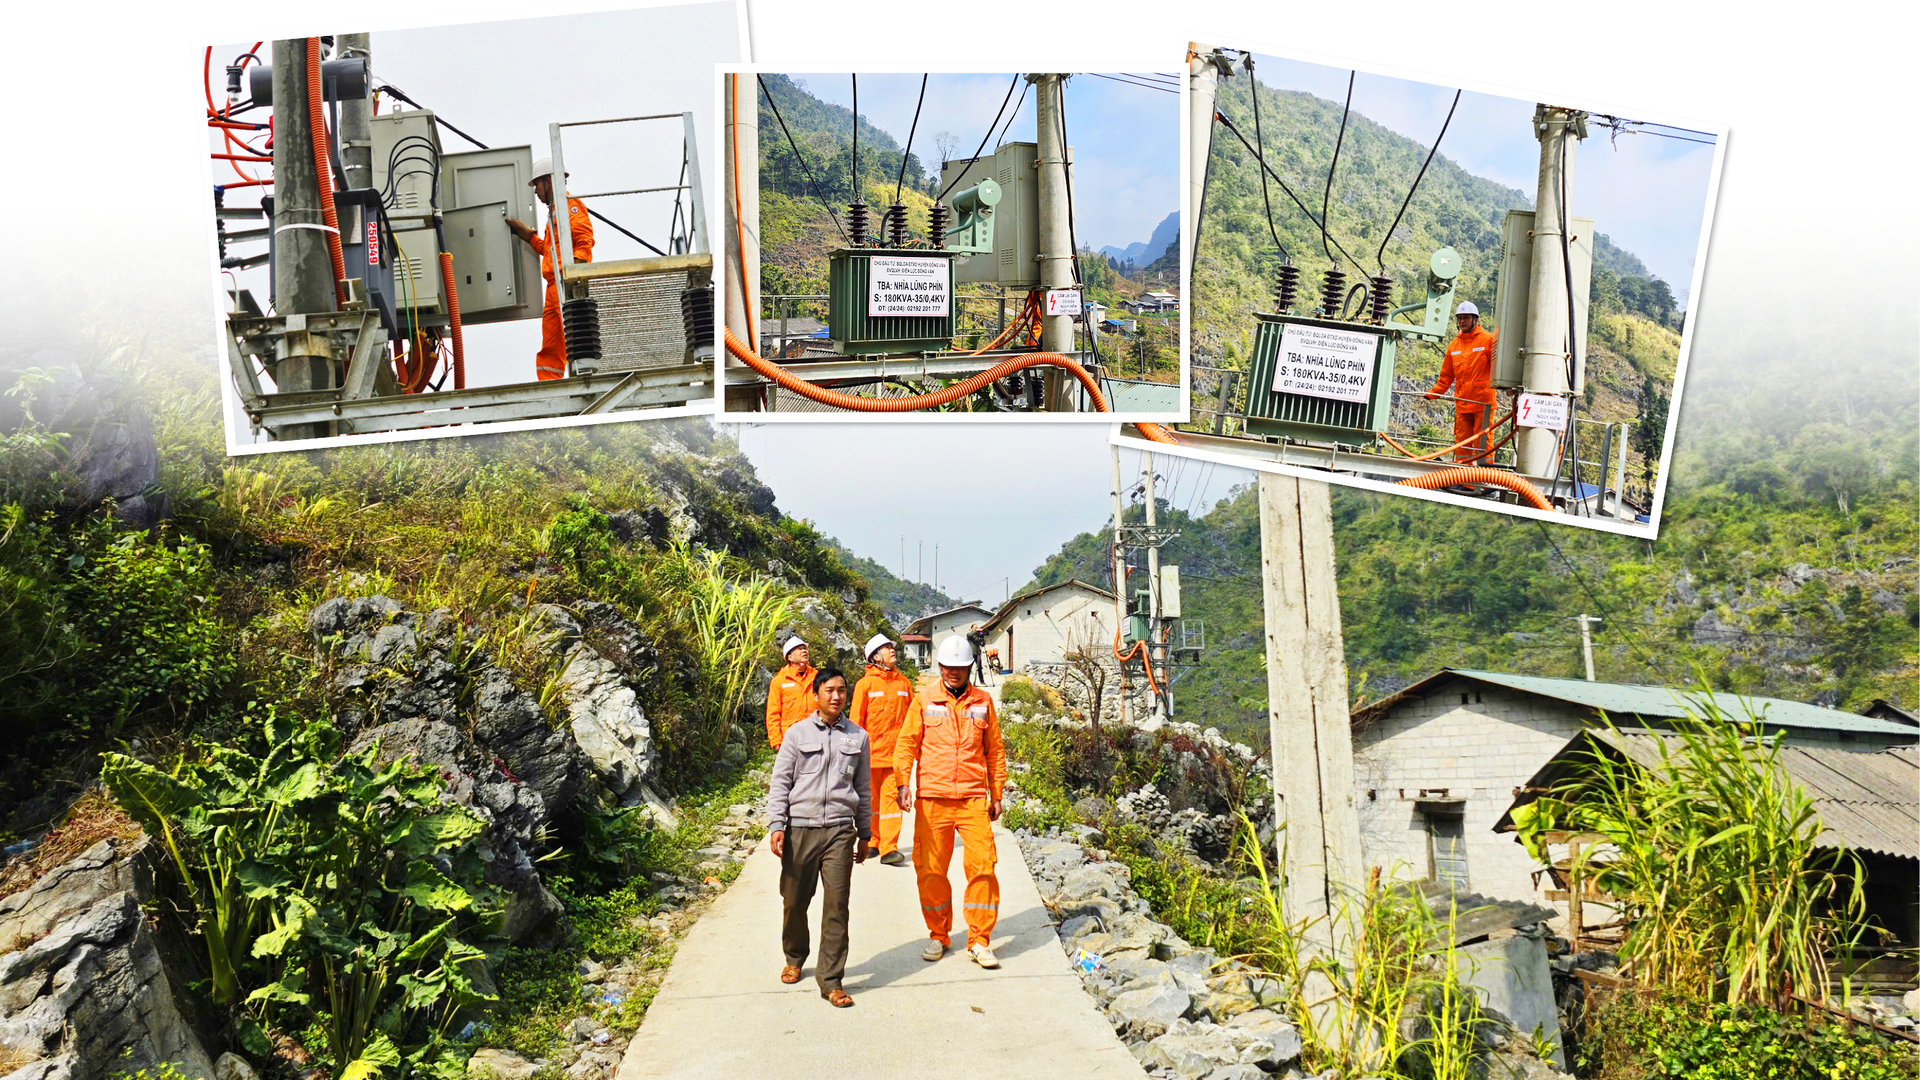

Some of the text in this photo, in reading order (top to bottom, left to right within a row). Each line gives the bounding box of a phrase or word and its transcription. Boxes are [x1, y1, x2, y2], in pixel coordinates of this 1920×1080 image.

[368, 222, 378, 264] 250549
[877, 281, 892, 290] TBA:
[874, 294, 946, 304] S: 180KVA-35/0,4KV
[1287, 352, 1304, 363] TBA:
[1280, 366, 1366, 386] S: 180KVA-35/0,4KV
